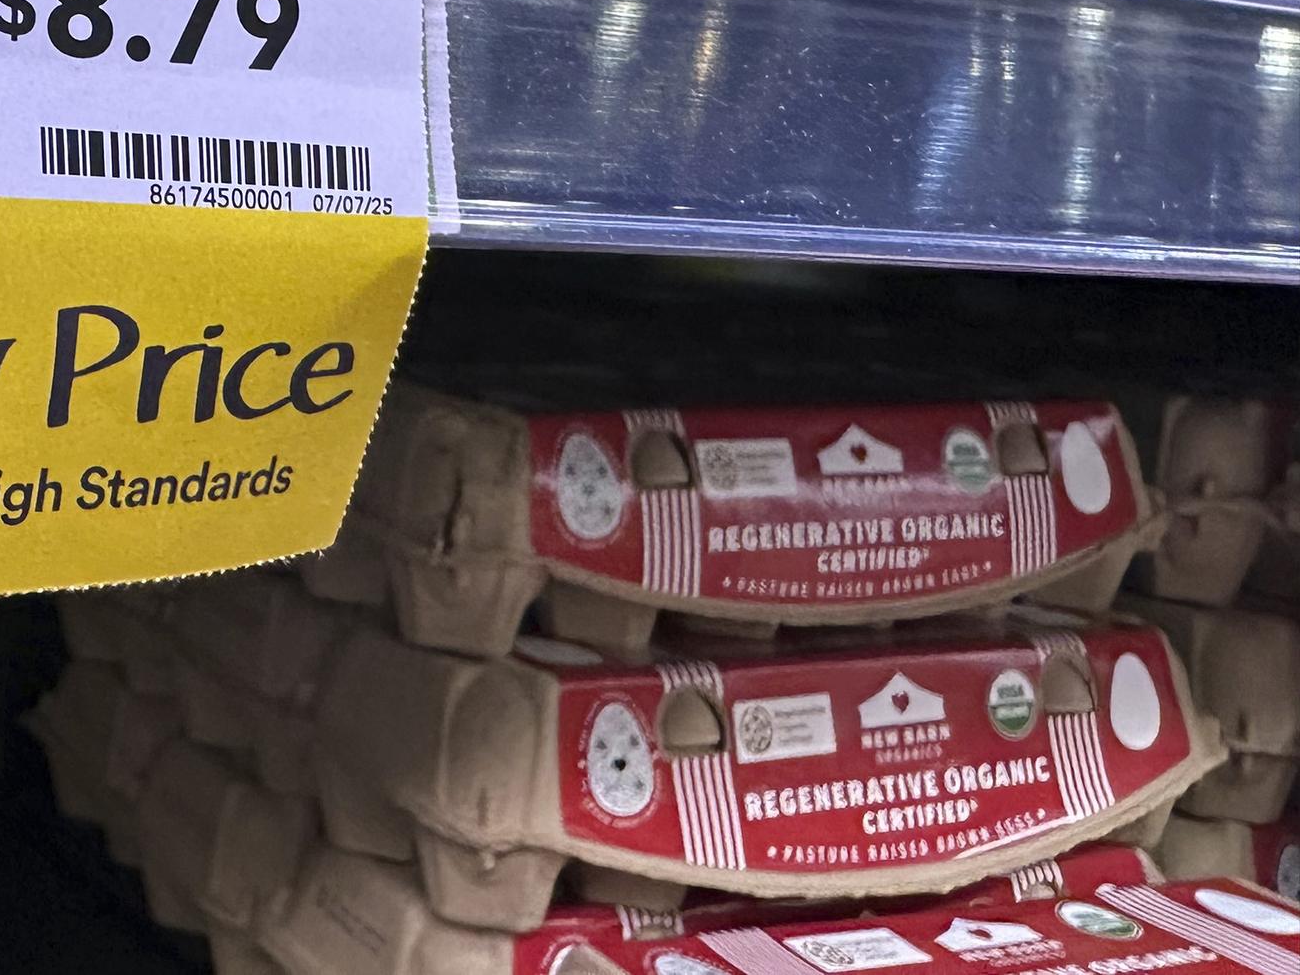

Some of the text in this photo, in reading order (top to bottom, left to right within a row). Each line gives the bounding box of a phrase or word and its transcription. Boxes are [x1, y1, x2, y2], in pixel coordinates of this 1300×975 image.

[150, 183, 393, 216] 86174500001 07/07/25
[47, 304, 354, 428] Price
[77, 456, 292, 510] Standards
[708, 513, 1005, 553] REGENERATIVE ORGANIC
[744, 756, 1051, 822] REGENERATIVE ORGANIC
